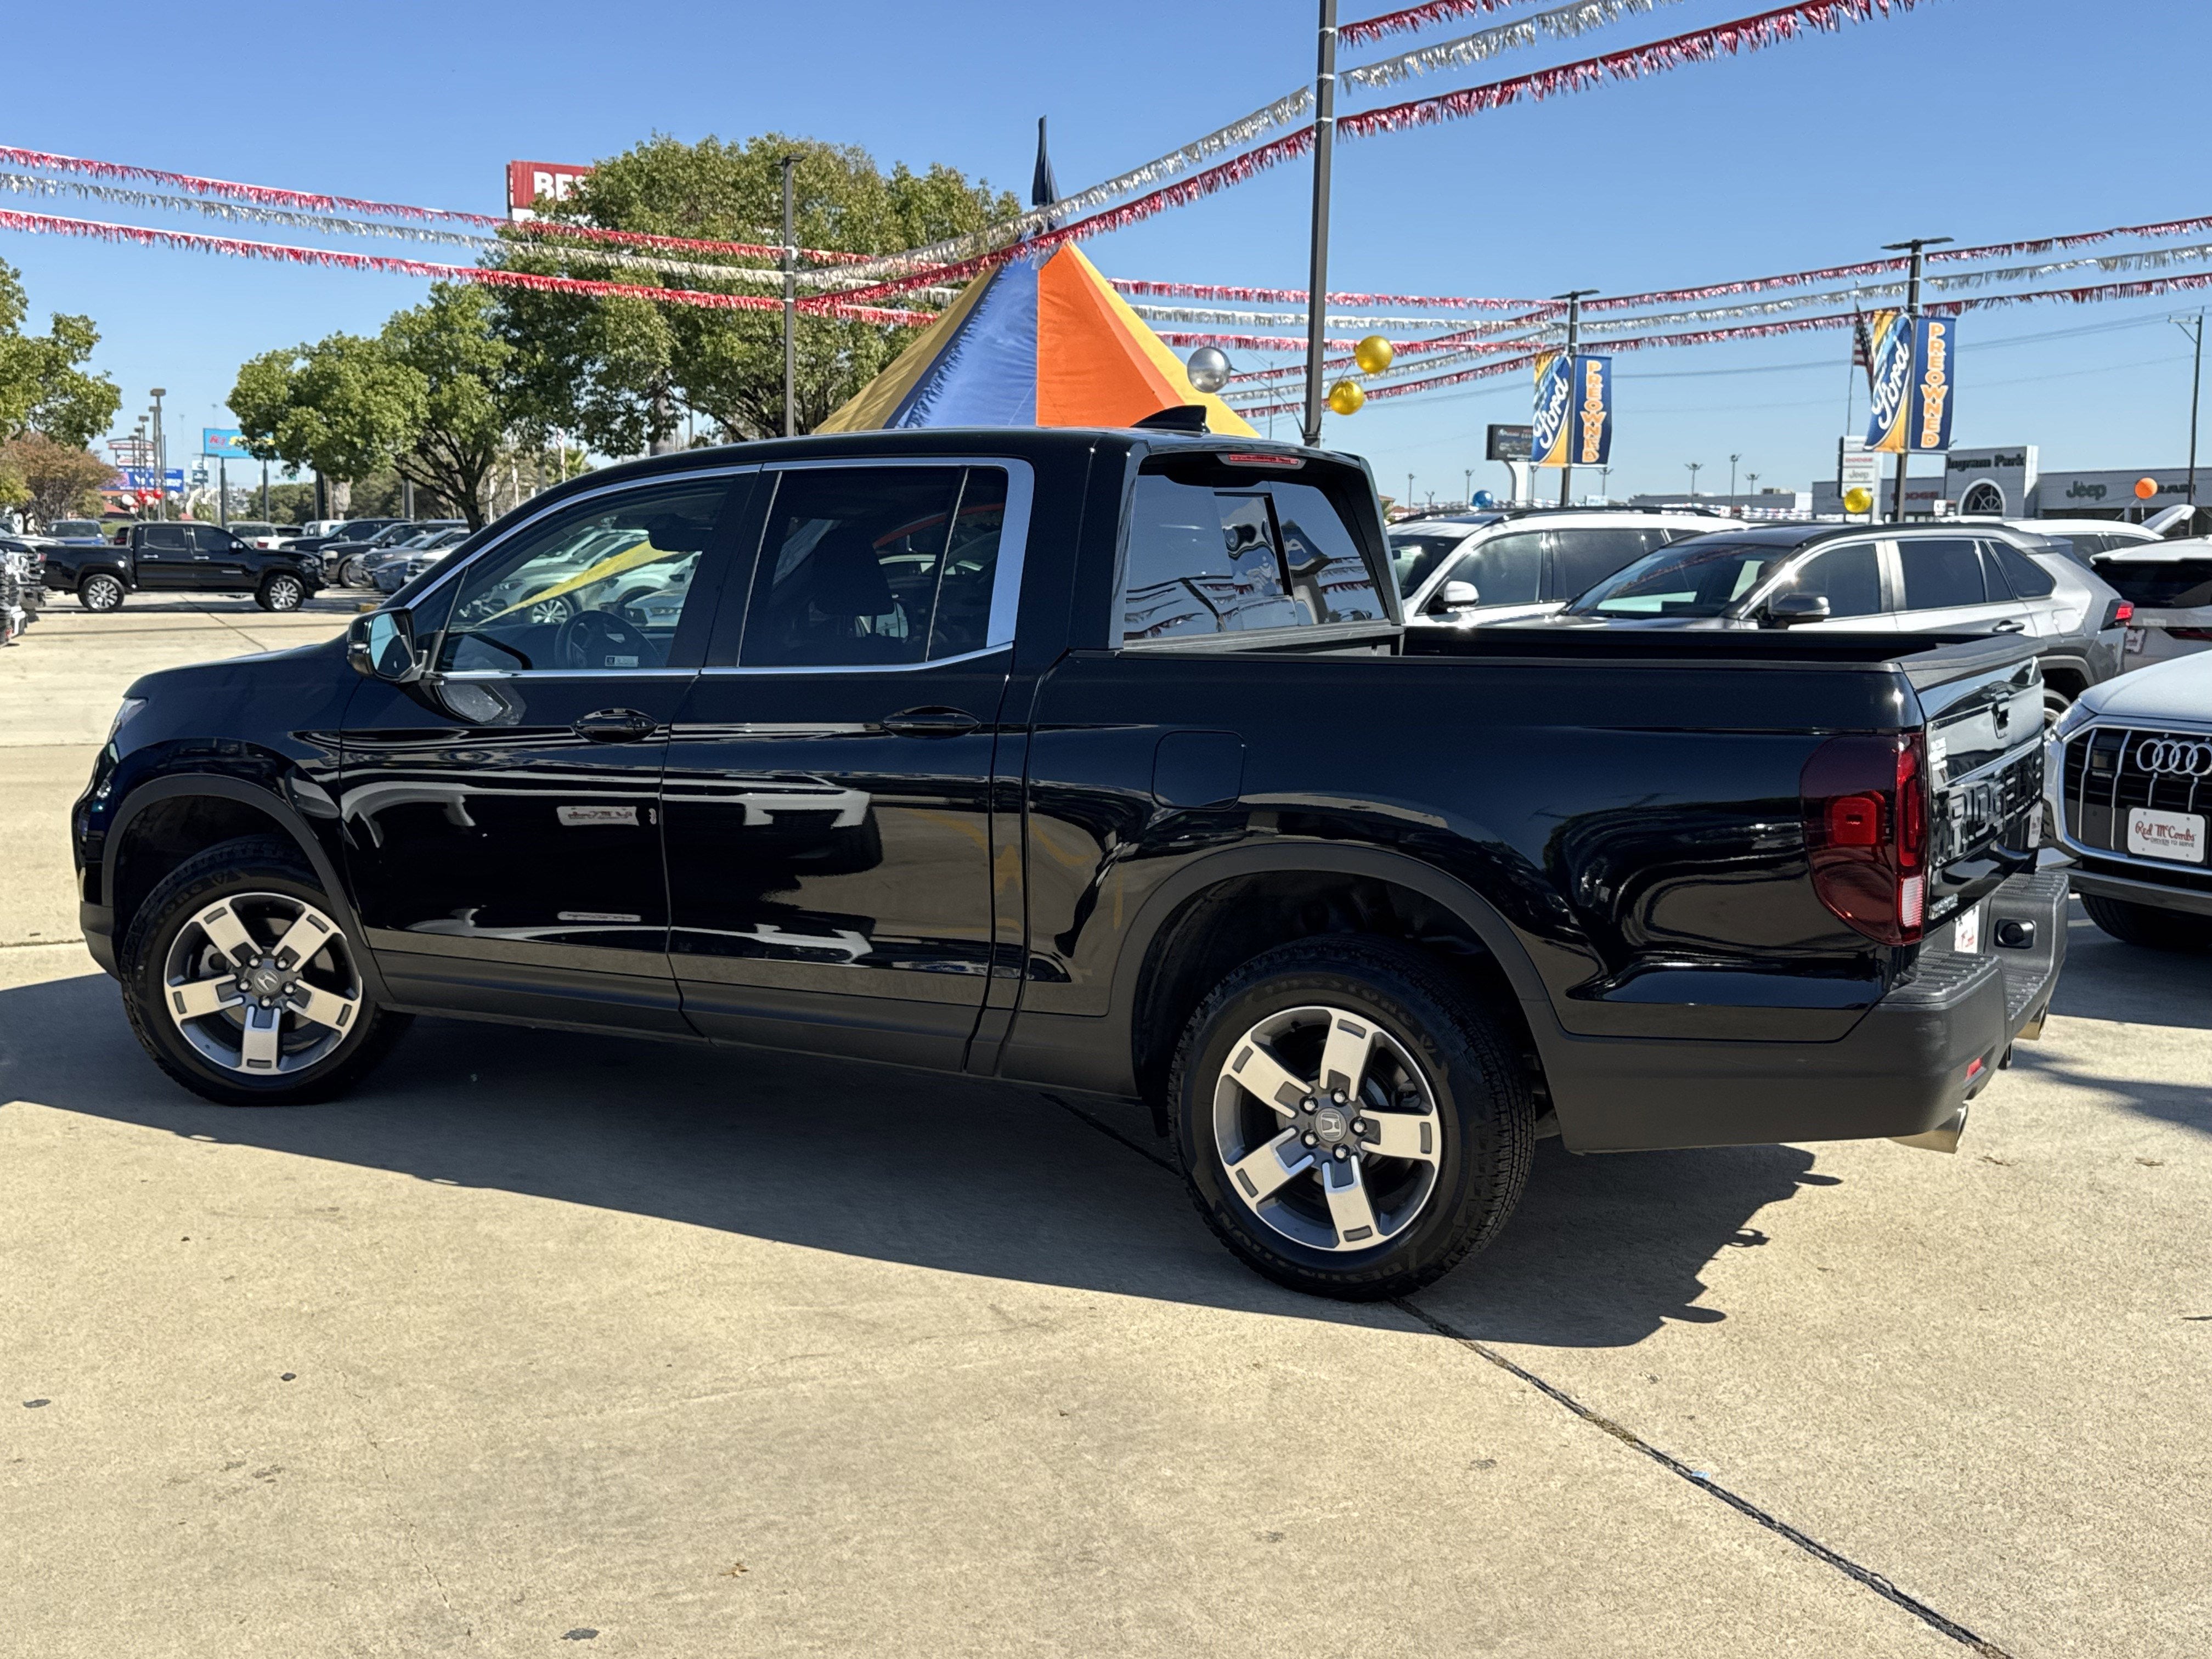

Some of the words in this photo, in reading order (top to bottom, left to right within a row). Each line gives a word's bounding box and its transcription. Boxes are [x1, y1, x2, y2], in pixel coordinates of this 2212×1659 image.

[1871, 339, 1910, 430] Ford
[1532, 372, 1569, 449] Ford
[1994, 454, 2024, 467] Park
[2065, 481, 2107, 501] Jeep
[2135, 820, 2153, 840] Red
[2154, 824, 2195, 842] McCombs
